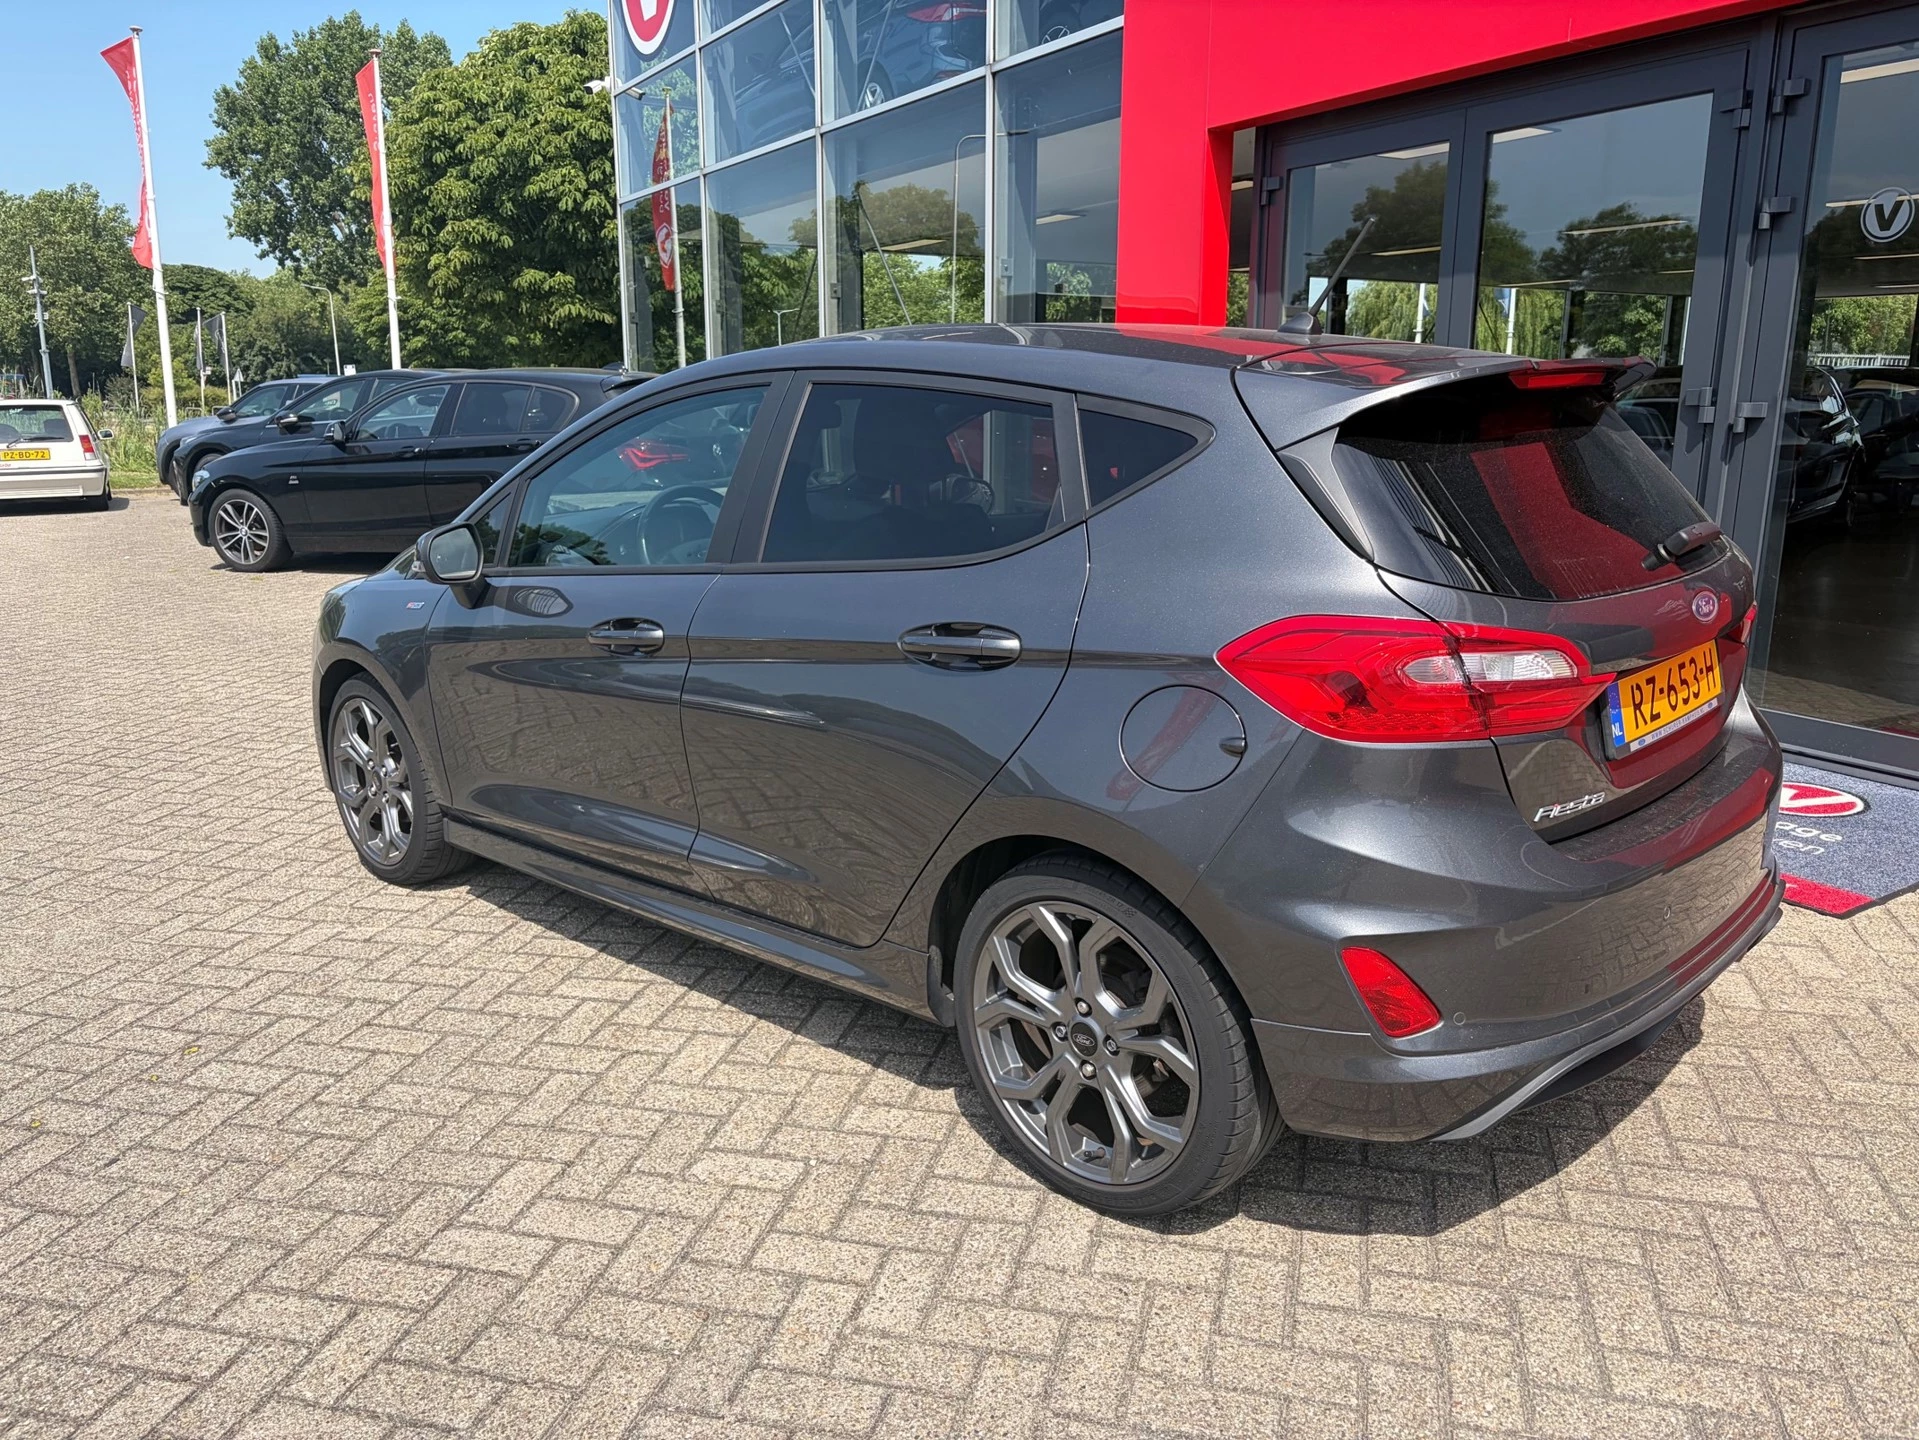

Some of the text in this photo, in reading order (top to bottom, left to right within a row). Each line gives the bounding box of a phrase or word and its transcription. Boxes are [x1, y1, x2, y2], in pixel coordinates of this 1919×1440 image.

[1631, 648, 1716, 729] RZ-653-H
[1611, 722, 1623, 738] NL
[1775, 822, 1842, 842] age
